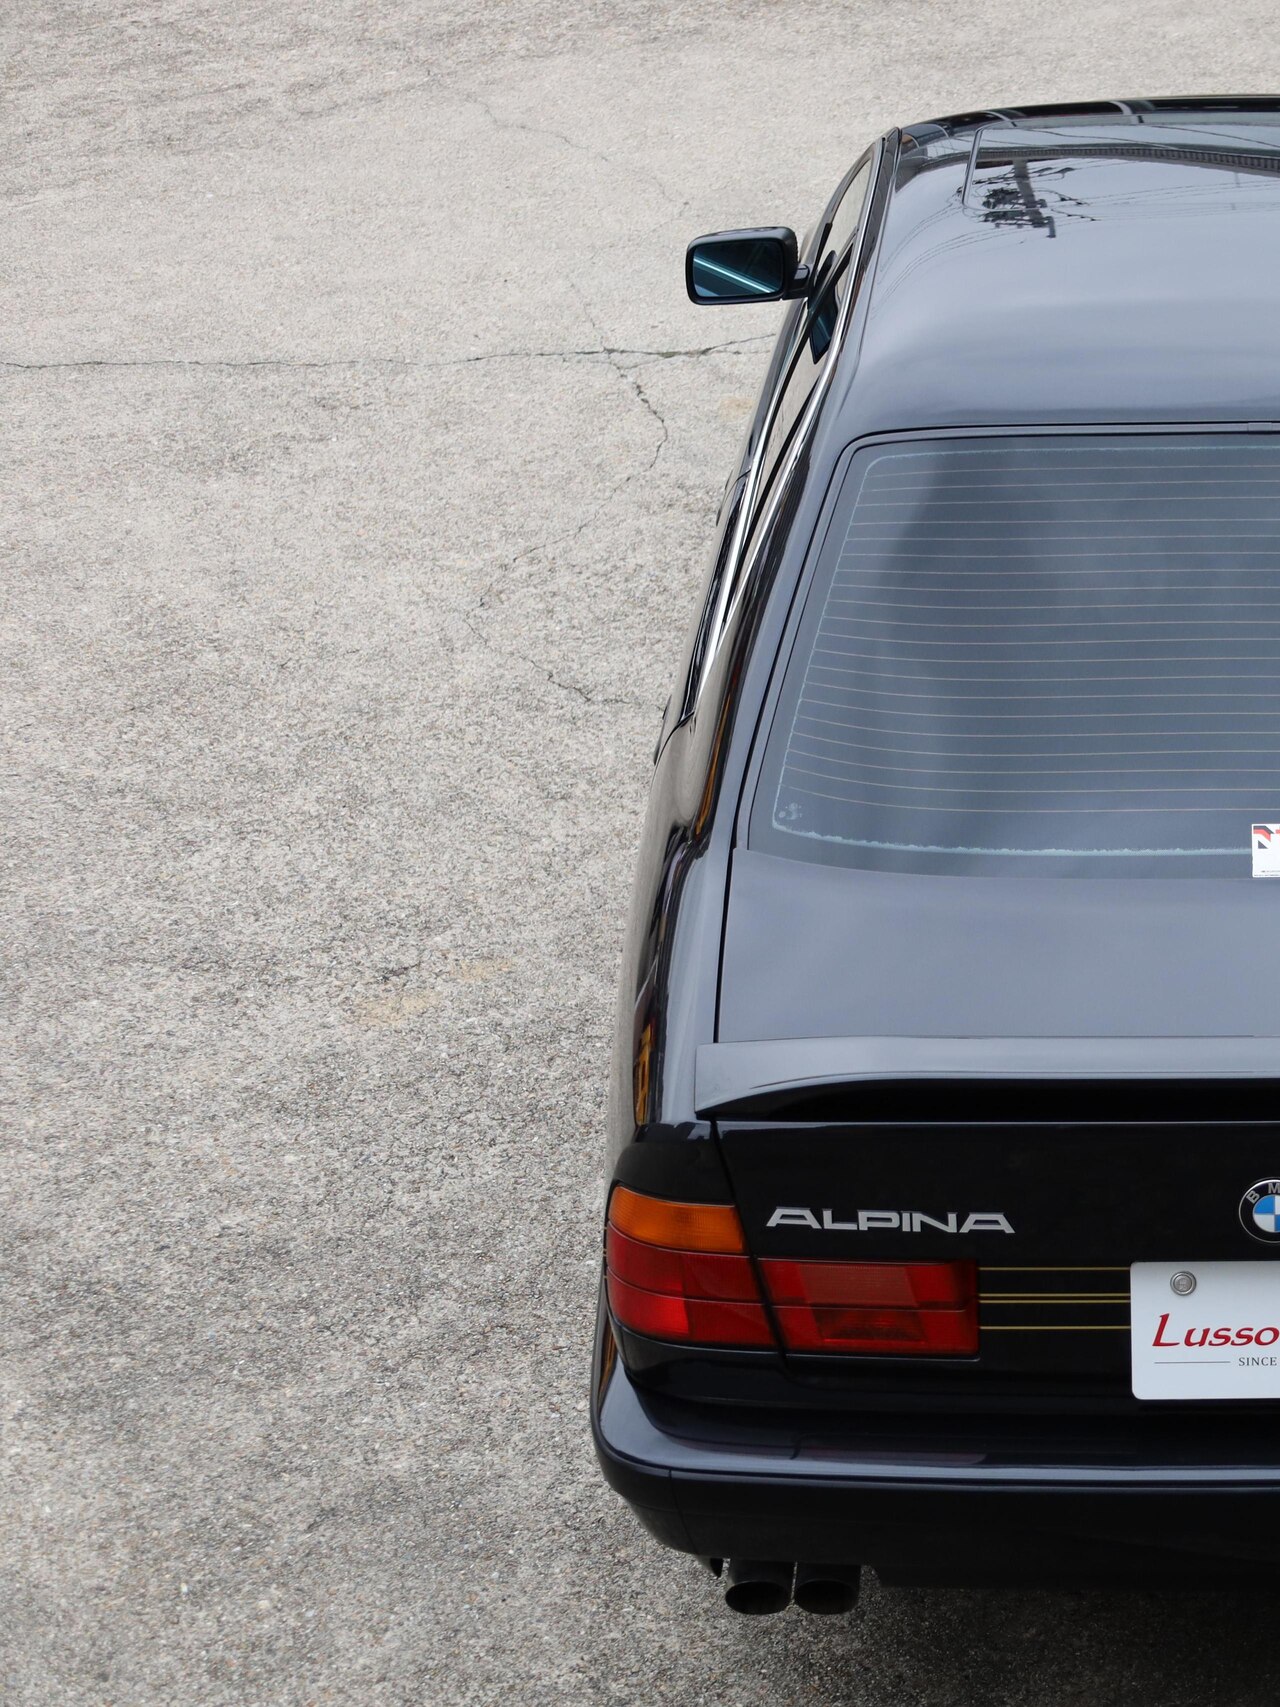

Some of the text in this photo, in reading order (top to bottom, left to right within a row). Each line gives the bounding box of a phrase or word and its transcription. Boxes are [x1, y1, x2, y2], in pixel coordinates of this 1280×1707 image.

[766, 1206, 1016, 1234] ALPINA
[1152, 1313, 1280, 1347] Lusso
[1238, 1356, 1277, 1367] SINCE
